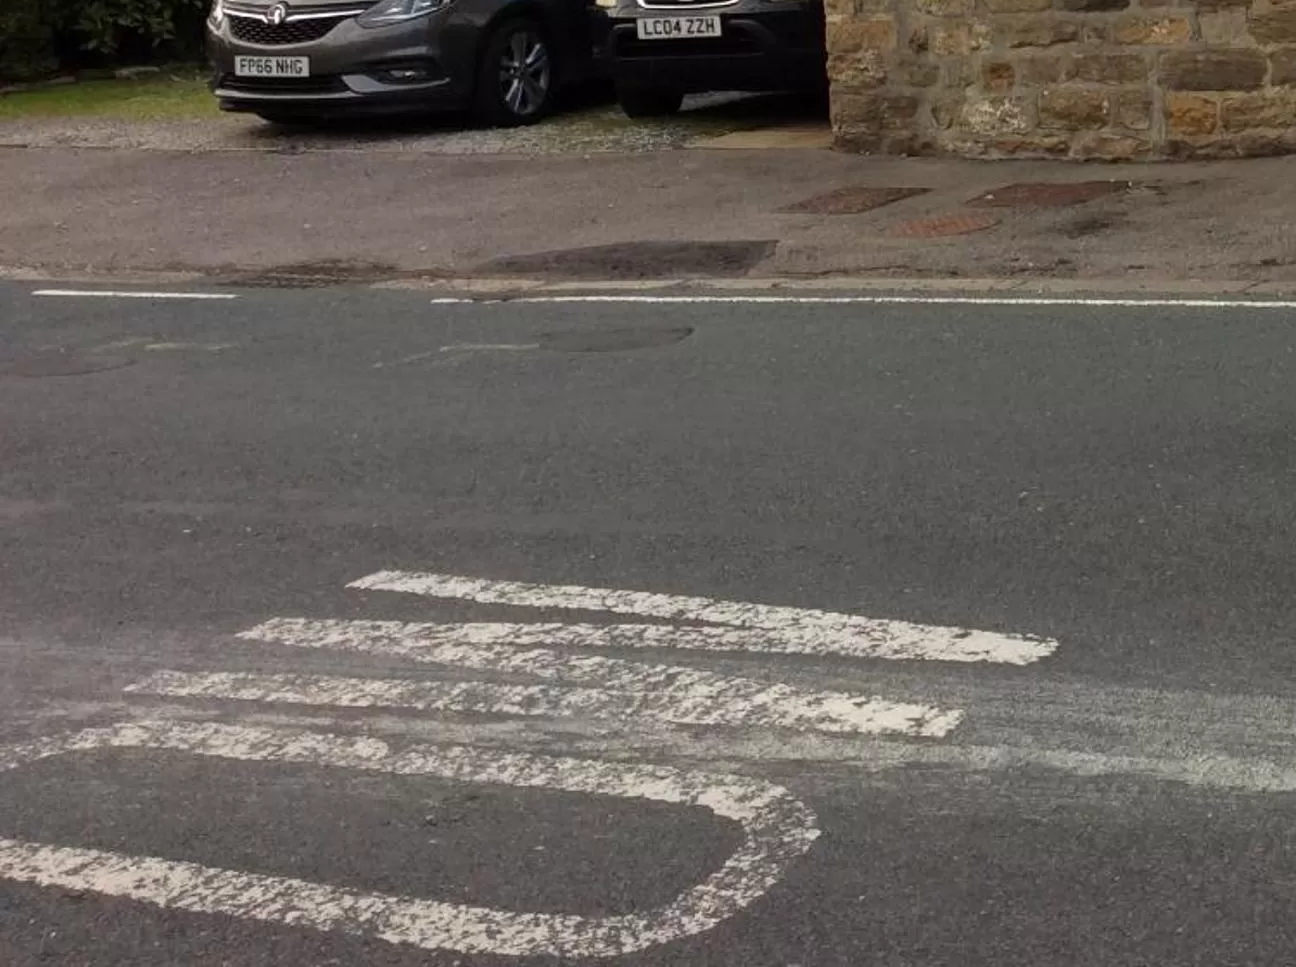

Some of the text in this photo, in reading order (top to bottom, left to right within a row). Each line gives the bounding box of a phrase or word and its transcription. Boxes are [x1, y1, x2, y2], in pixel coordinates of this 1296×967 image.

[643, 17, 715, 35] LC04 ZZH
[240, 57, 304, 74] FP66 NHG
